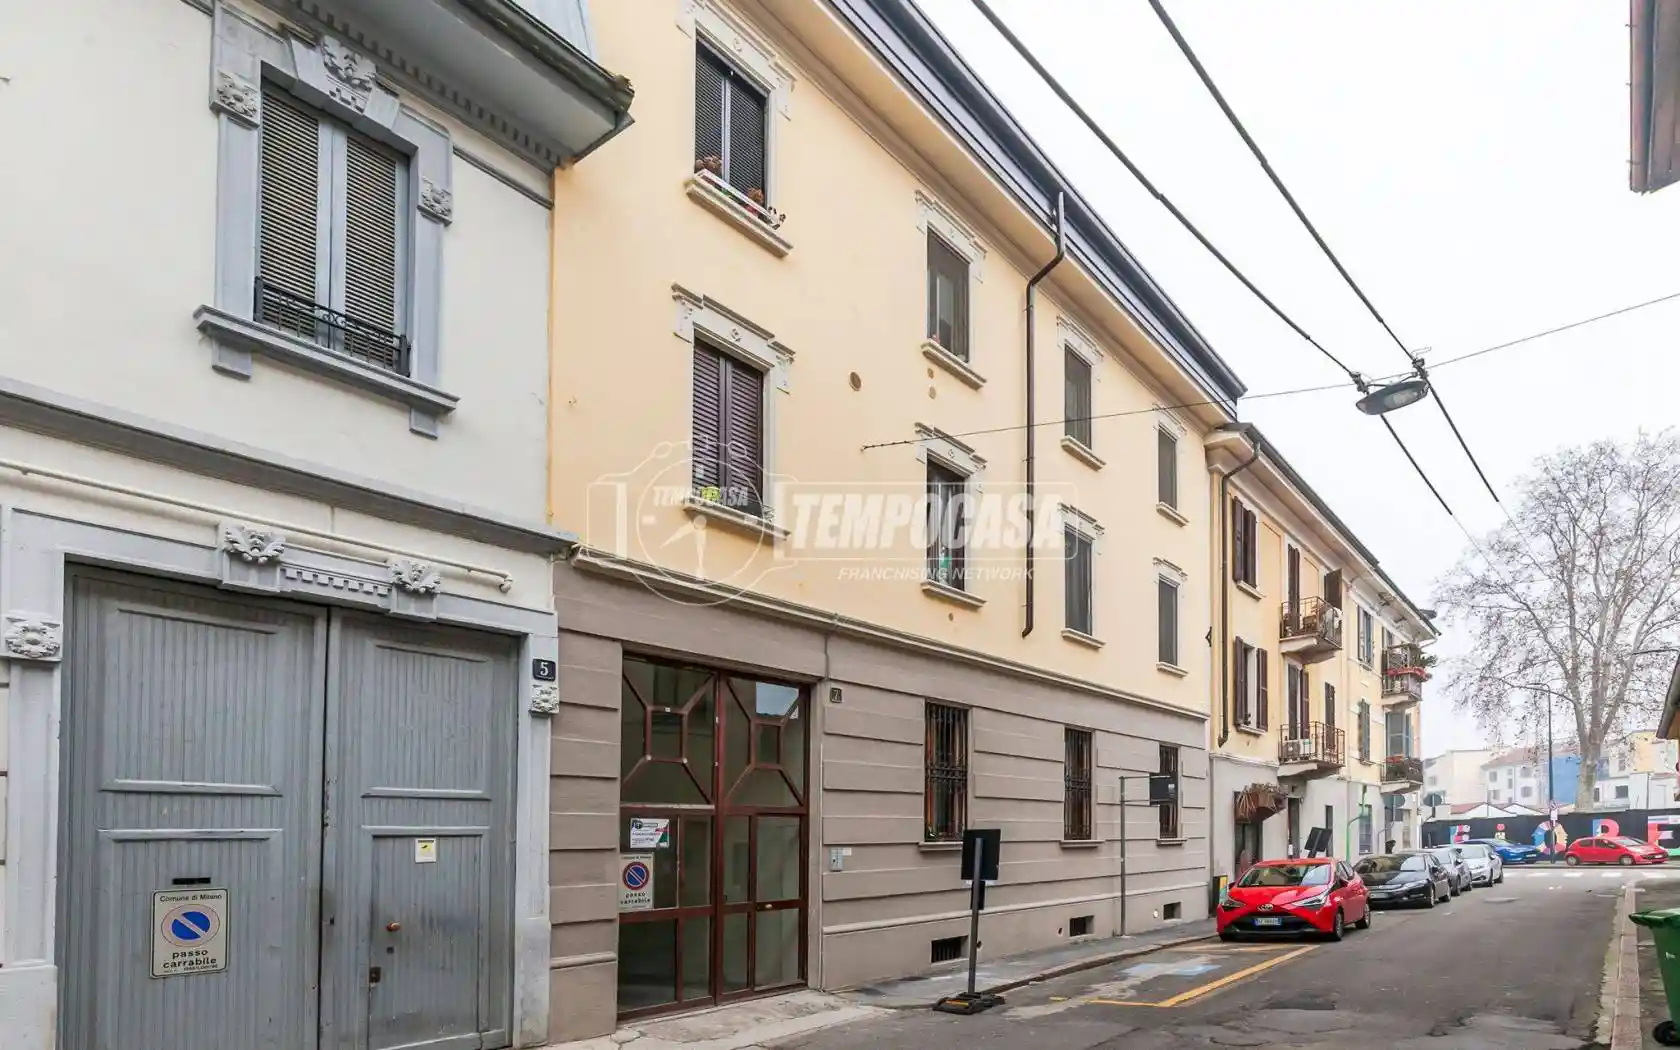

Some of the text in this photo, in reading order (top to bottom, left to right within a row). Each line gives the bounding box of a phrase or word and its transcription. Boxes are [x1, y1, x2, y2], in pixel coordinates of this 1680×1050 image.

[540, 661, 549, 676] 5
[200, 893, 222, 901] Milano
[172, 949, 208, 959] passo
[163, 958, 217, 969] carrabile
